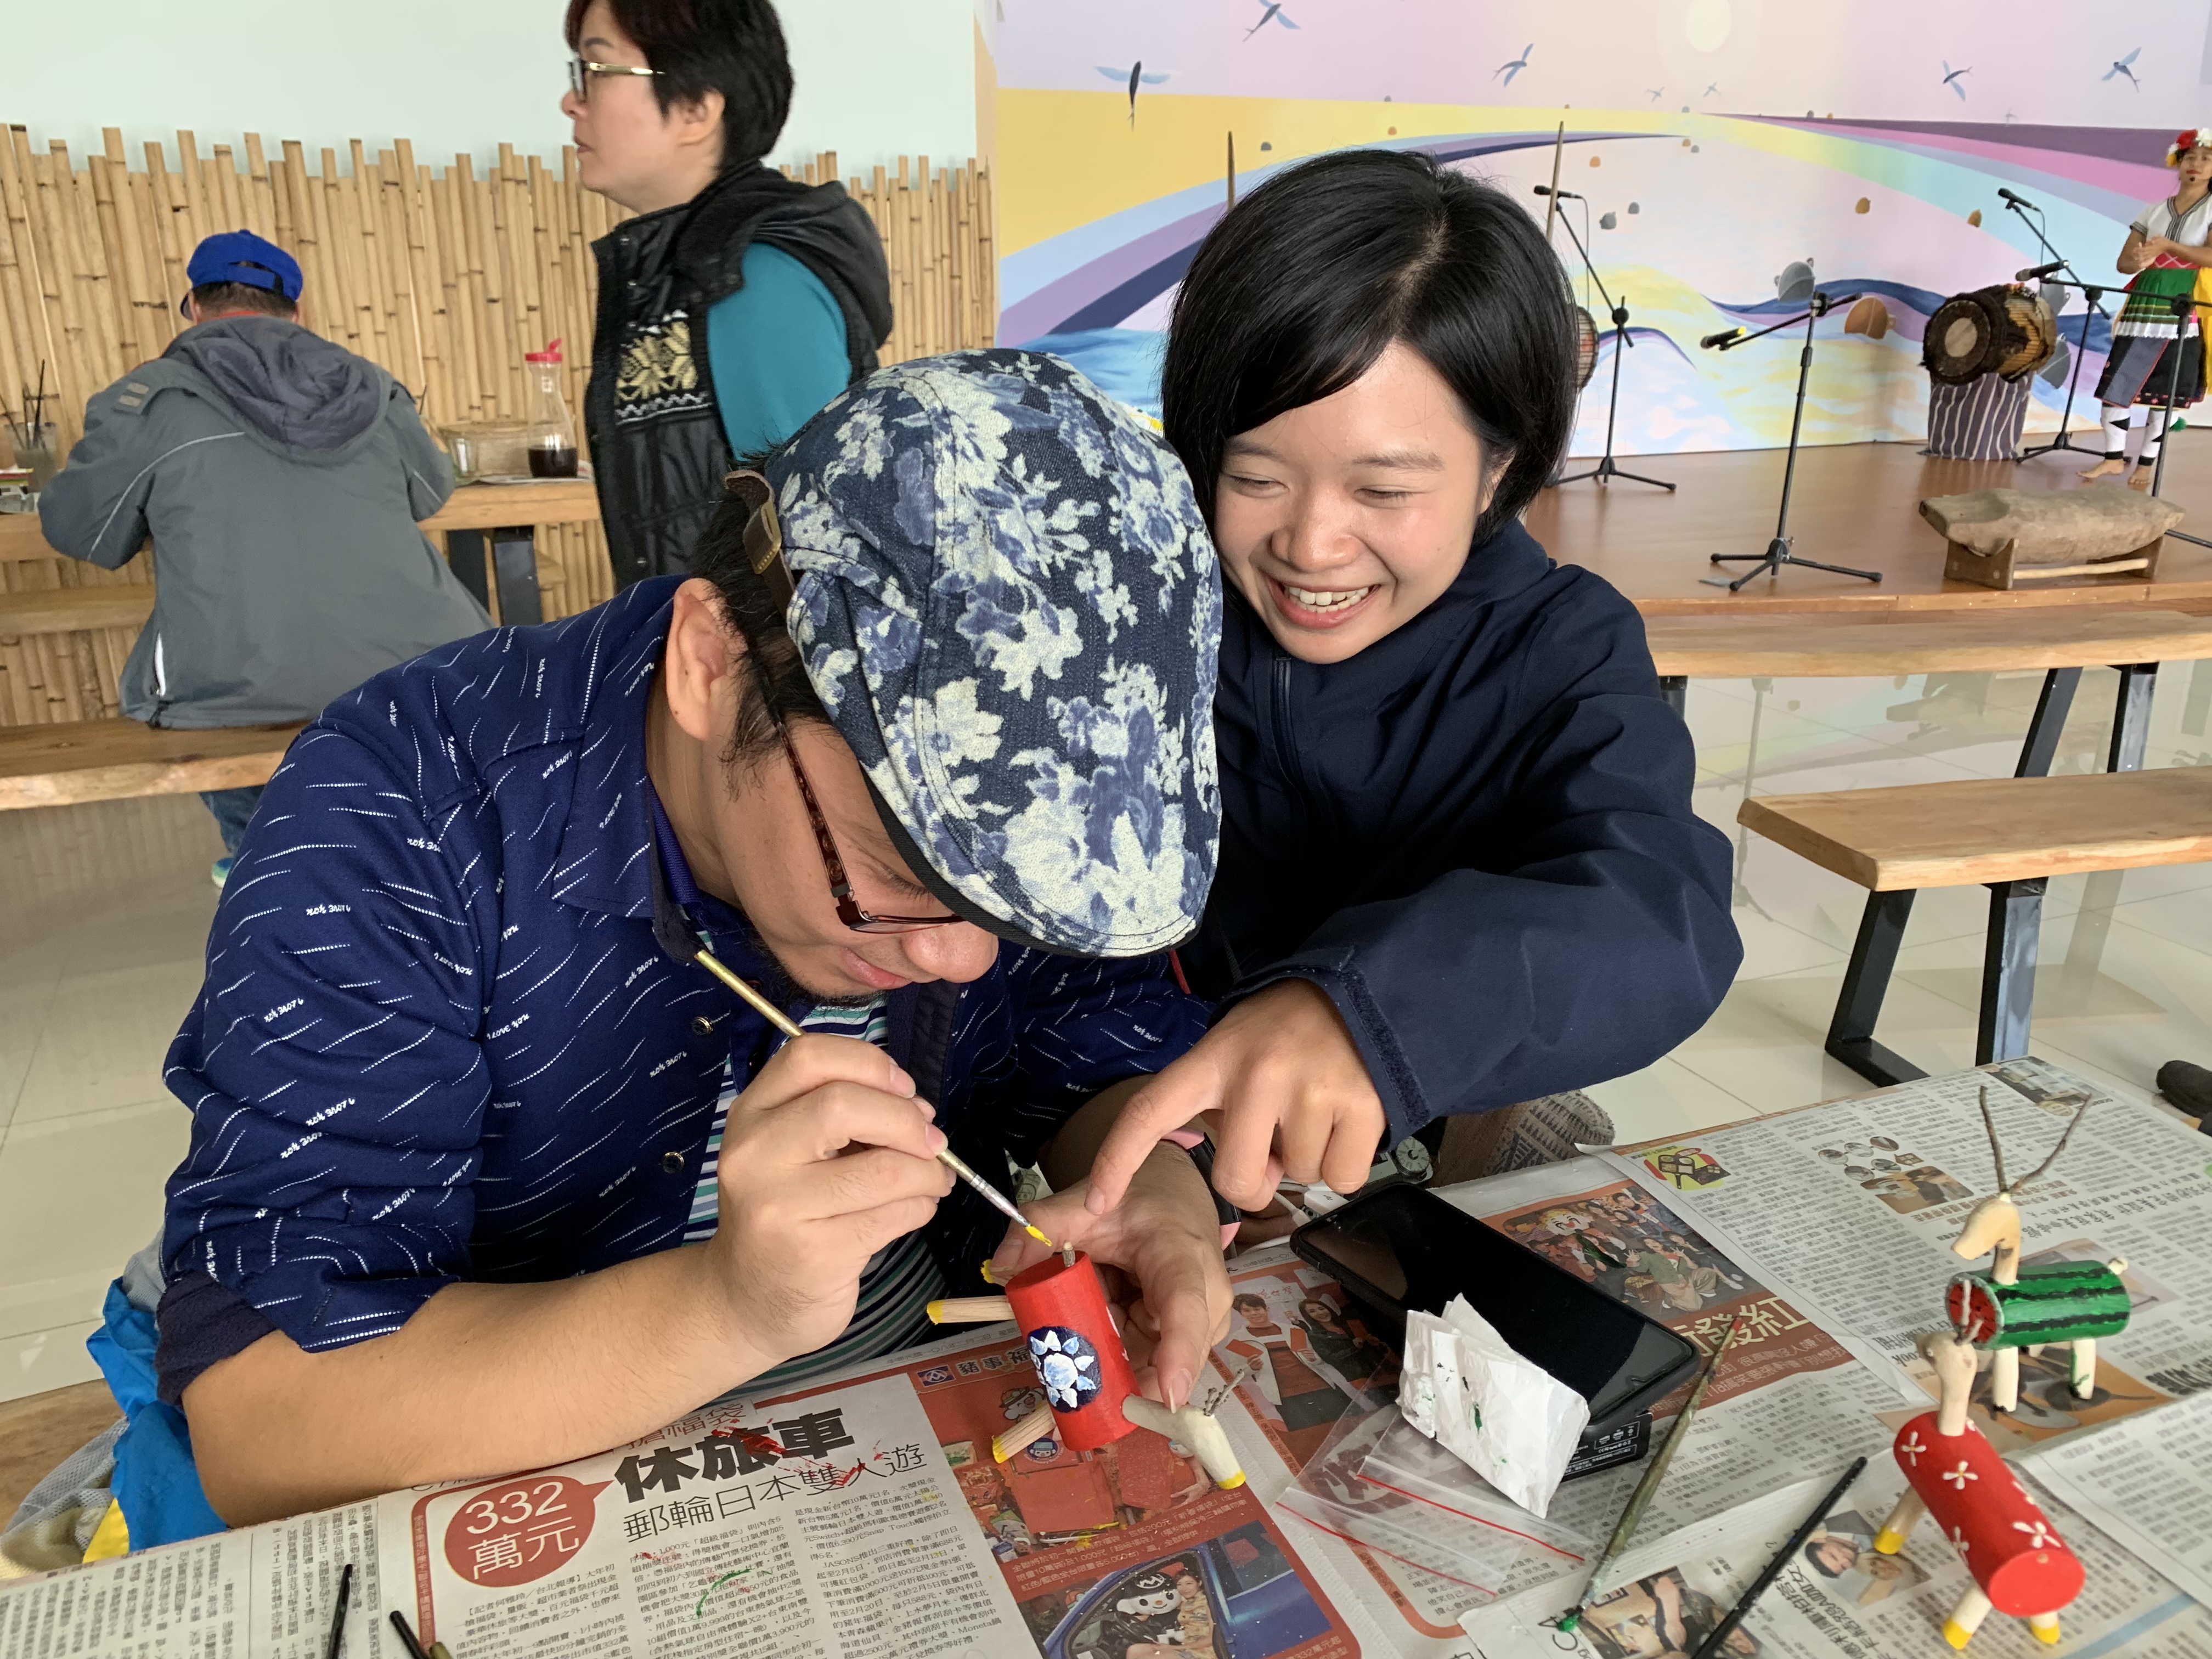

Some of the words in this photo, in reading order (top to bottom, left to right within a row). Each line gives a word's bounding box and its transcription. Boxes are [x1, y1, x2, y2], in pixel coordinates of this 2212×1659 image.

[957, 1345, 1033, 1378] 豬事福
[614, 1408, 856, 1504] 休旅車
[465, 1480, 568, 1536] 332
[623, 1443, 927, 1544] 郵輪日本雙人遊
[468, 1516, 580, 1580] 萬元
